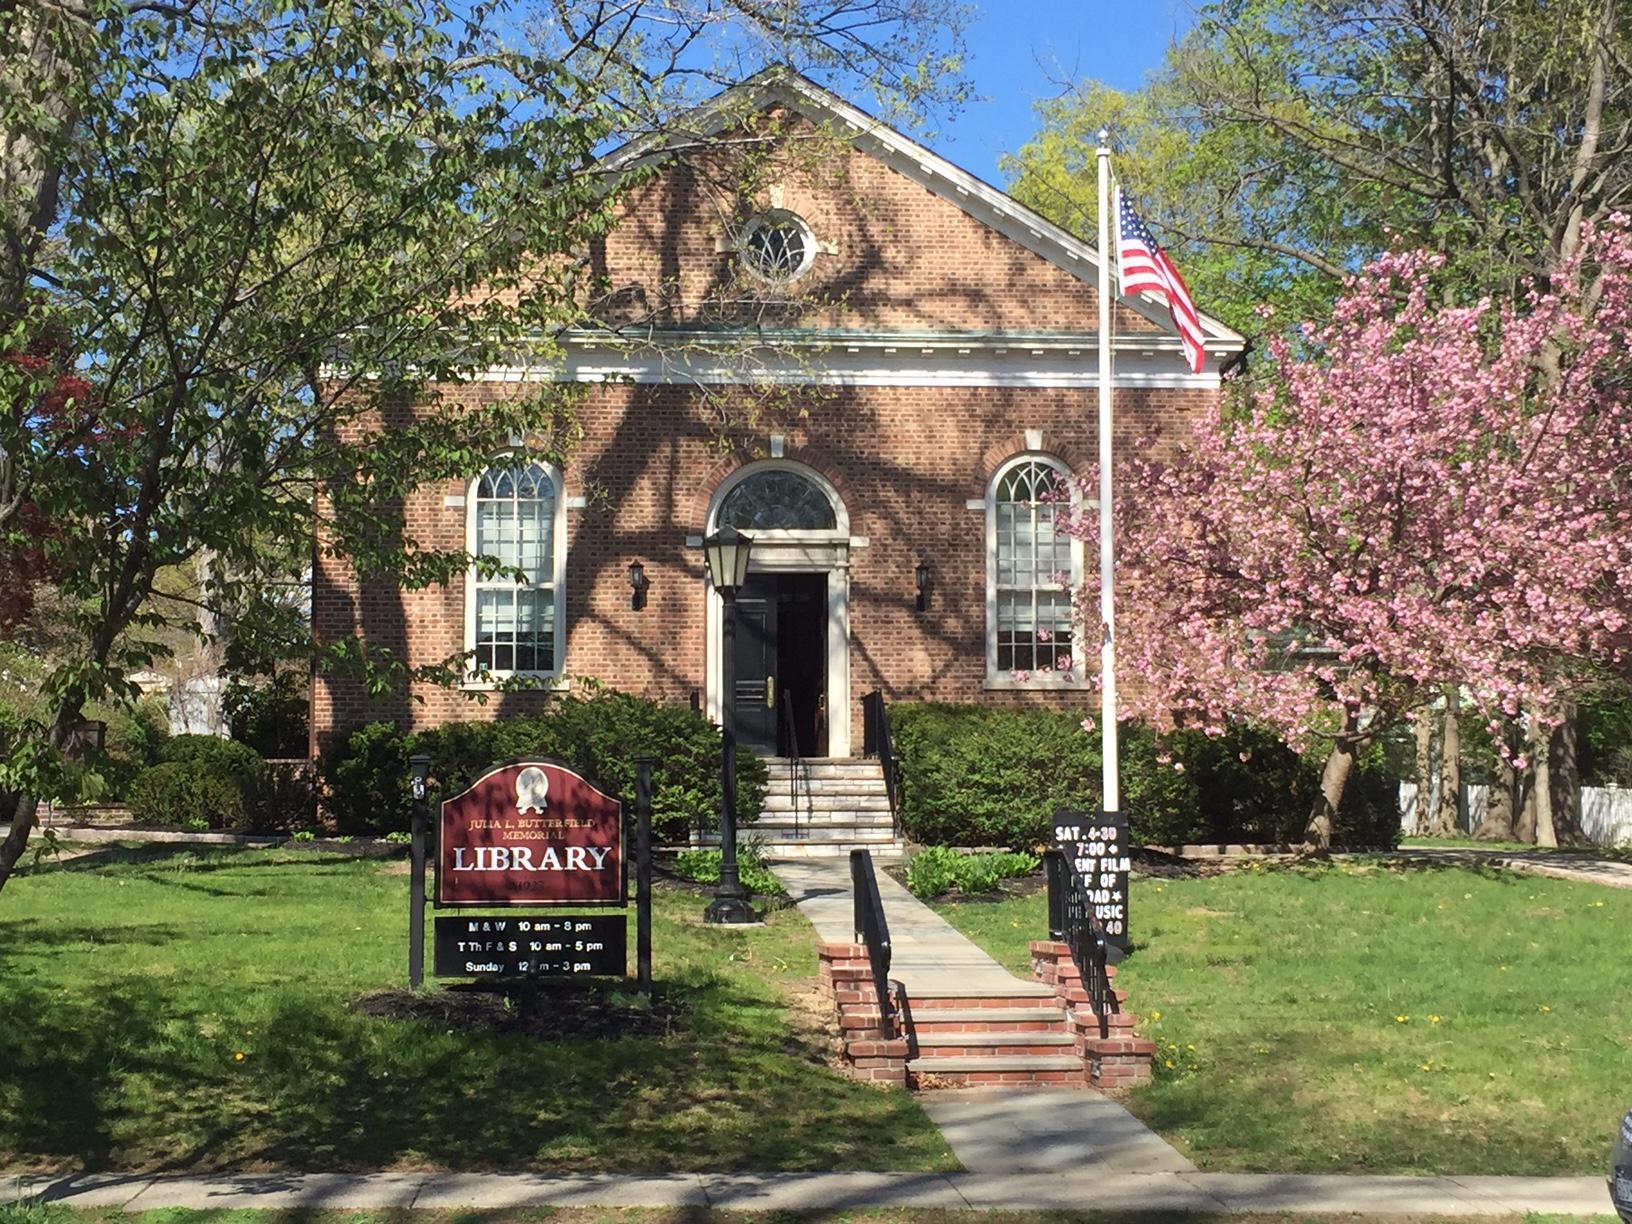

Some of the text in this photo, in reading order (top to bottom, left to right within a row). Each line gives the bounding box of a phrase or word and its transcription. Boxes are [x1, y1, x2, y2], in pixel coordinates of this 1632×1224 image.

[469, 819, 500, 831] JULIA
[518, 818, 595, 829] BUTTERFIELD
[502, 831, 566, 841] MEMORIAL
[1076, 842, 1105, 856] 7:00
[453, 846, 612, 872] LIBRARY
[1074, 857, 1131, 873] ENT FILM
[1101, 873, 1117, 888] OF
[1089, 904, 1123, 919] USIC
[468, 921, 479, 932] M
[482, 921, 491, 932] &
[495, 921, 506, 932] W
[518, 921, 531, 932] 10
[534, 923, 551, 931] am
[564, 921, 572, 931] 8
[575, 923, 592, 932] pm
[457, 942, 466, 952] T
[468, 941, 482, 952] Th
[485, 942, 493, 951] F
[496, 941, 505, 951] &
[508, 941, 518, 952] S
[529, 941, 542, 951] 10
[545, 943, 562, 951] am
[575, 941, 583, 951] 5
[586, 942, 603, 952] pm
[465, 961, 505, 973] Sunday
[518, 961, 529, 971] 12
[562, 961, 571, 971] 3
[573, 962, 591, 973] pm
